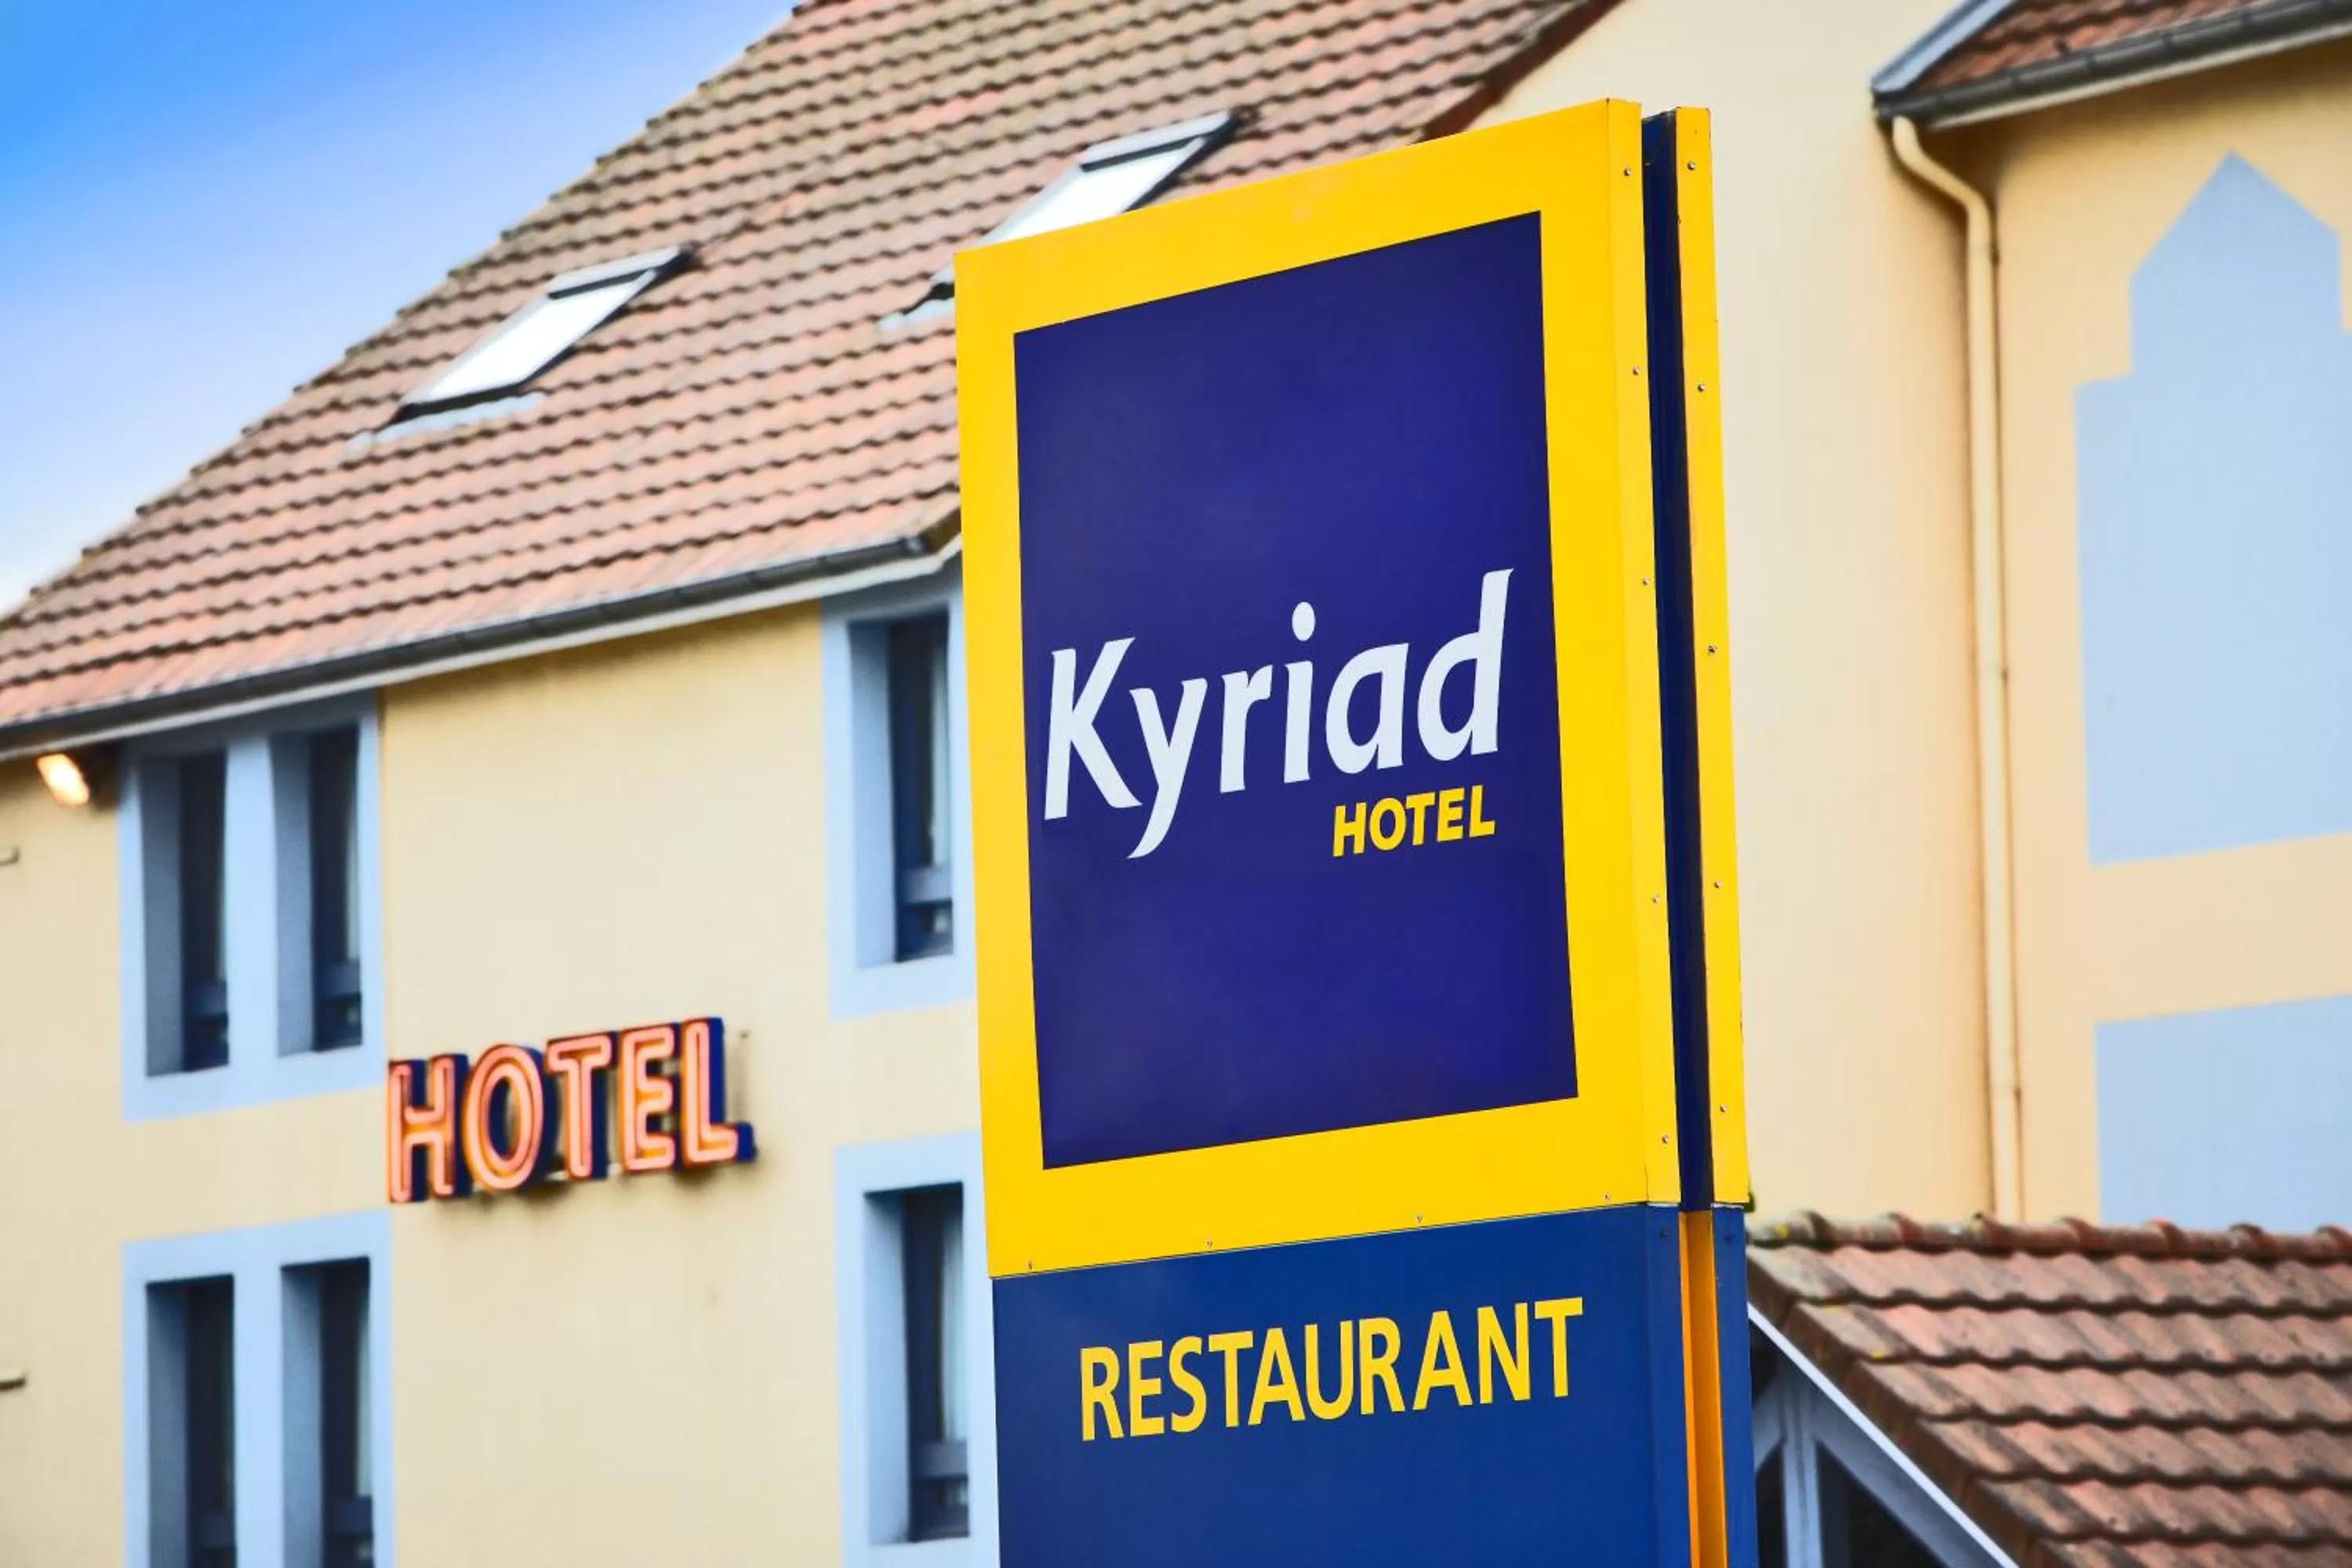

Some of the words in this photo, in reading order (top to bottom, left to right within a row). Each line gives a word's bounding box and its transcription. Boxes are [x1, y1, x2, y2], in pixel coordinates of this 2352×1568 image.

[1044, 568, 1514, 859] Kyriad
[1332, 784, 1496, 857] HOTEL
[387, 1017, 754, 1203] HOTEL
[1080, 1297, 1584, 1443] RESTAURANT
